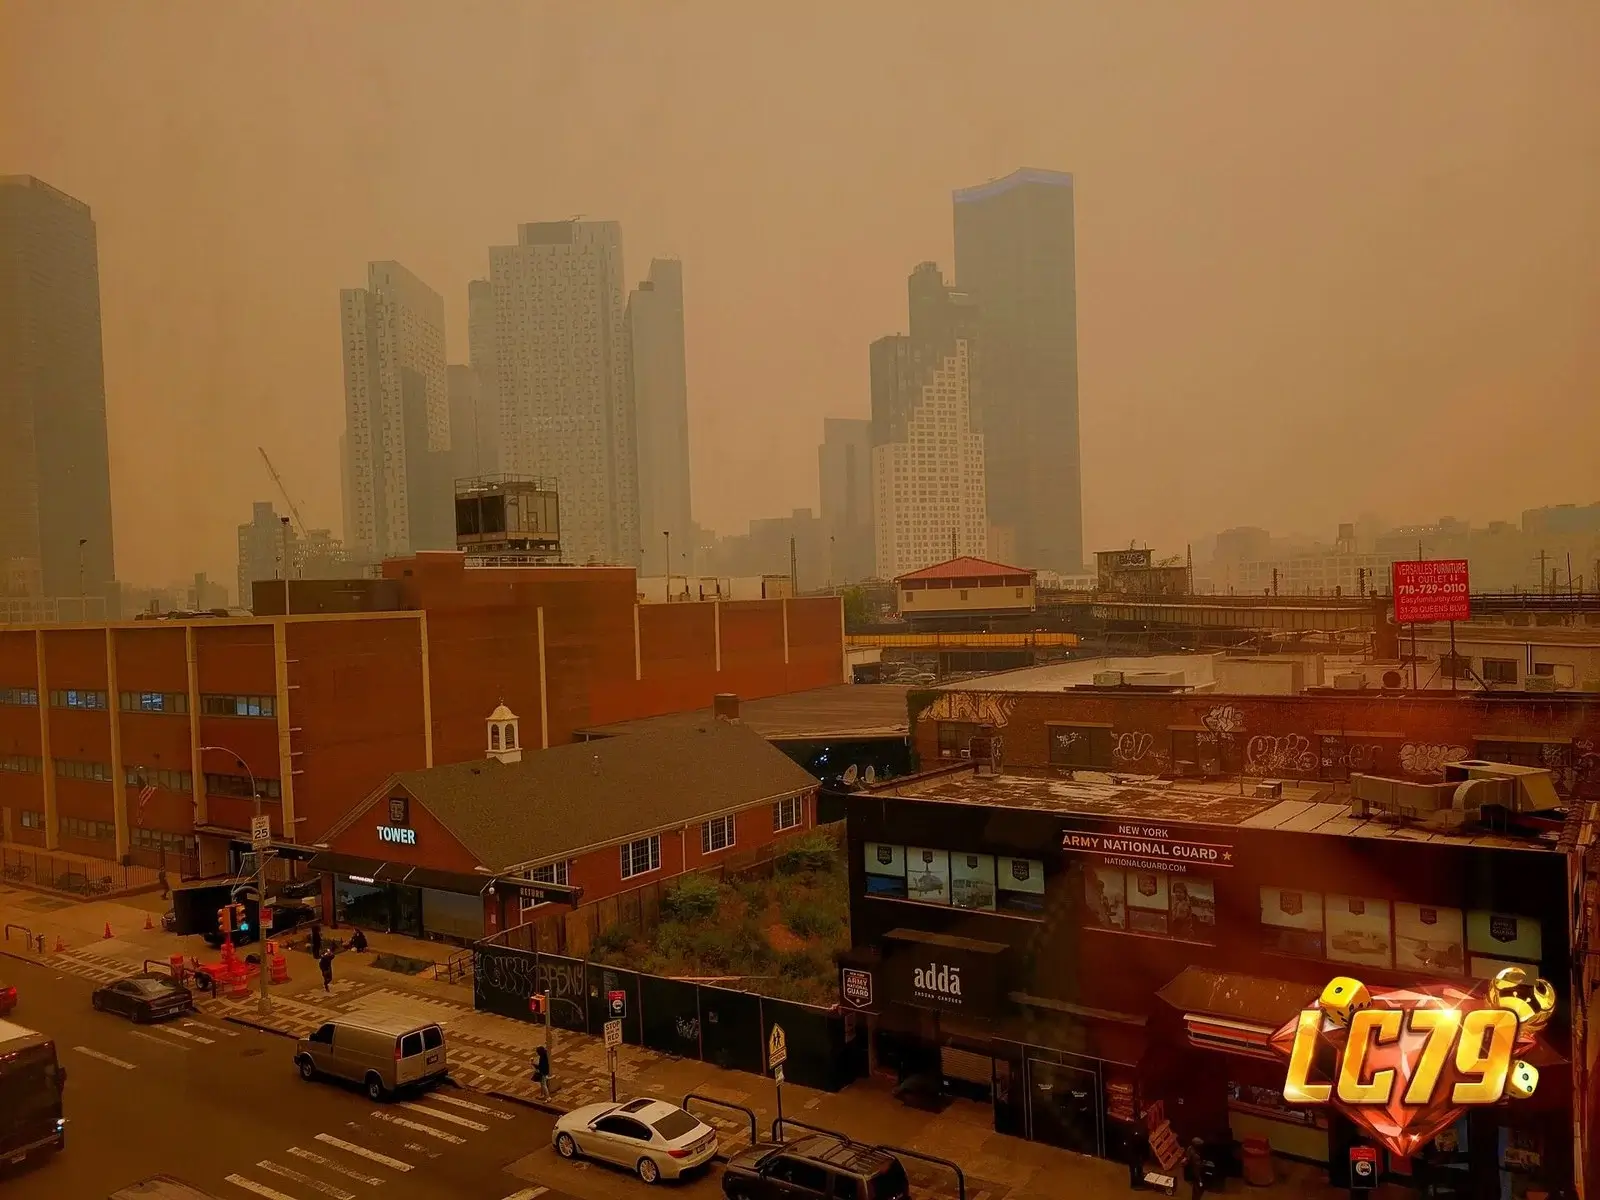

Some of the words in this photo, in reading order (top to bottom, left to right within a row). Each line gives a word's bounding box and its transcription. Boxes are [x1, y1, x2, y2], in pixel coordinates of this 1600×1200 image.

[1398, 563, 1432, 575] VERSAILLES
[1433, 562, 1466, 574] FURNITURE
[1418, 575, 1447, 584] OUTLET
[1399, 583, 1466, 594] 718-729-0110
[1419, 605, 1448, 613] QUEENS
[1449, 604, 1467, 612] BLVD
[254, 828, 269, 839] 25
[376, 825, 416, 845] TOWER
[1118, 825, 1140, 835] NEW
[1142, 827, 1169, 838] YORK
[1062, 835, 1099, 848] ARMY
[1103, 839, 1169, 855] NATIONAL
[1172, 845, 1218, 860] GUARD
[1104, 857, 1187, 873] NATIONALGUARD.COM
[847, 977, 868, 986] ARMY
[846, 987, 869, 997] GUARD
[605, 1021, 621, 1031] STOP
[607, 1033, 620, 1041] RED
